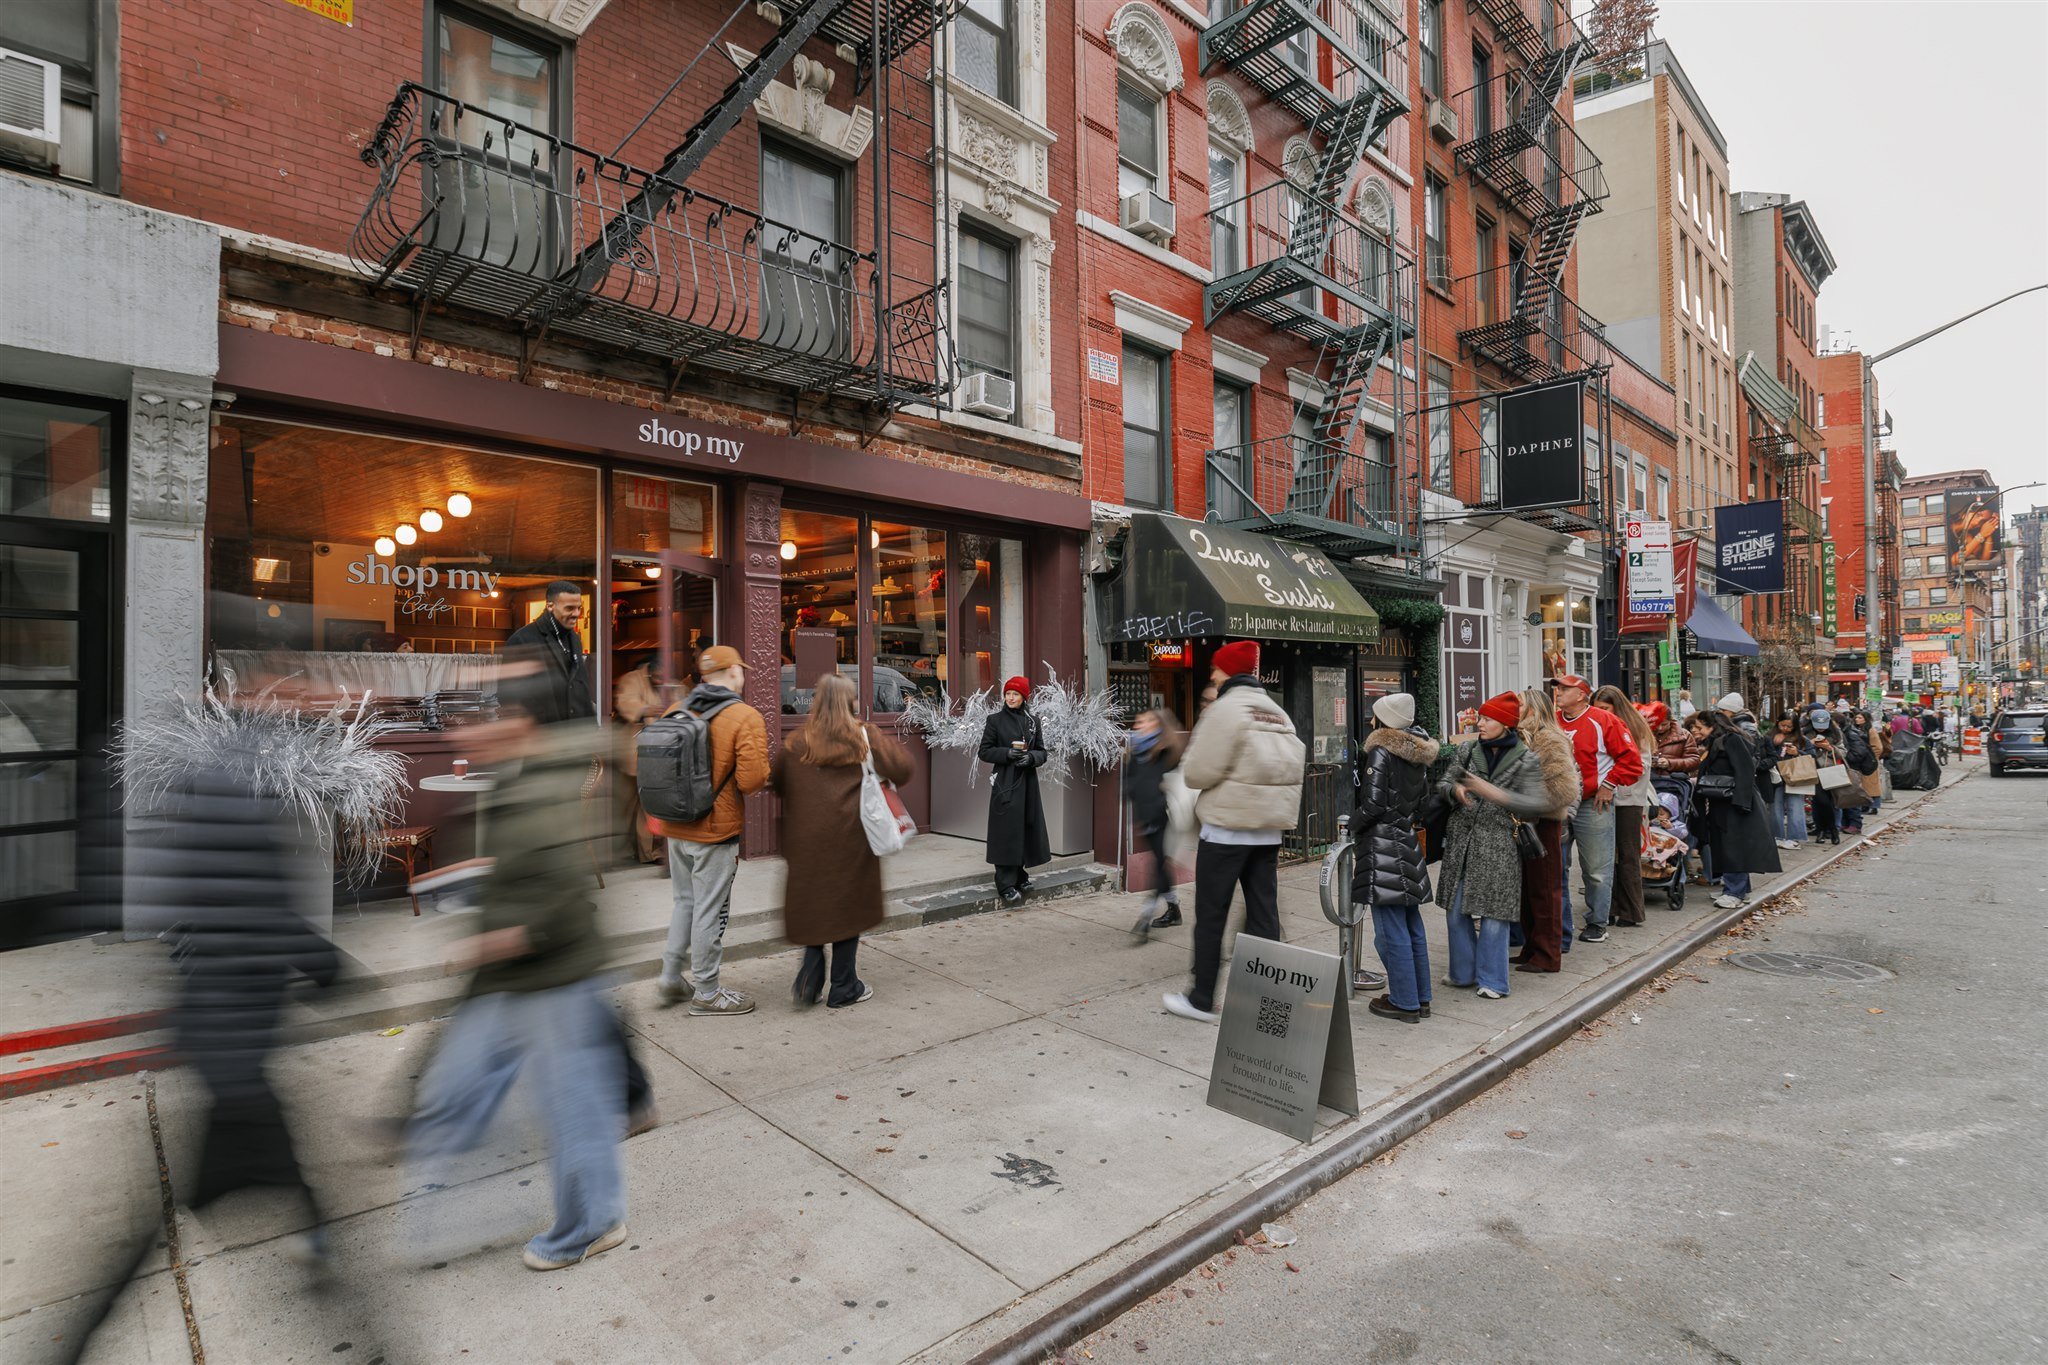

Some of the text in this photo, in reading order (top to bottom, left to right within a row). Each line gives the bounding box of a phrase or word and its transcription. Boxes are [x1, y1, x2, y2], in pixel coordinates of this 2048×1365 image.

[638, 418, 745, 463] shop my
[1507, 437, 1573, 457] DAPHNE
[1189, 528, 1270, 569] Quan
[1722, 532, 1775, 557] STONE
[1722, 545, 1775, 567] STREET
[1631, 553, 1640, 566] 2
[1825, 545, 1835, 586] CAFE
[347, 553, 501, 599] shop my
[1256, 573, 1335, 611] Sushi
[402, 595, 453, 619] Cafe
[1631, 603, 1665, 612] 106977
[1228, 616, 1243, 630] 375
[1245, 612, 1287, 635] Japanese
[1290, 615, 1335, 635] Restaurant
[1153, 645, 1182, 655] SAPPORO
[1360, 637, 1416, 657] DAPHNE
[1260, 669, 1280, 683] rill
[1245, 956, 1319, 993] shop my
[1226, 1046, 1245, 1061] Your
[1247, 1055, 1272, 1070] world
[1273, 1064, 1285, 1074] of
[1232, 1063, 1295, 1094] brought to life.
[1221, 1079, 1233, 1087] Come
[1252, 1090, 1273, 1101] chocolate
[1274, 1098, 1283, 1106] and
[1287, 1103, 1304, 1112] chance
